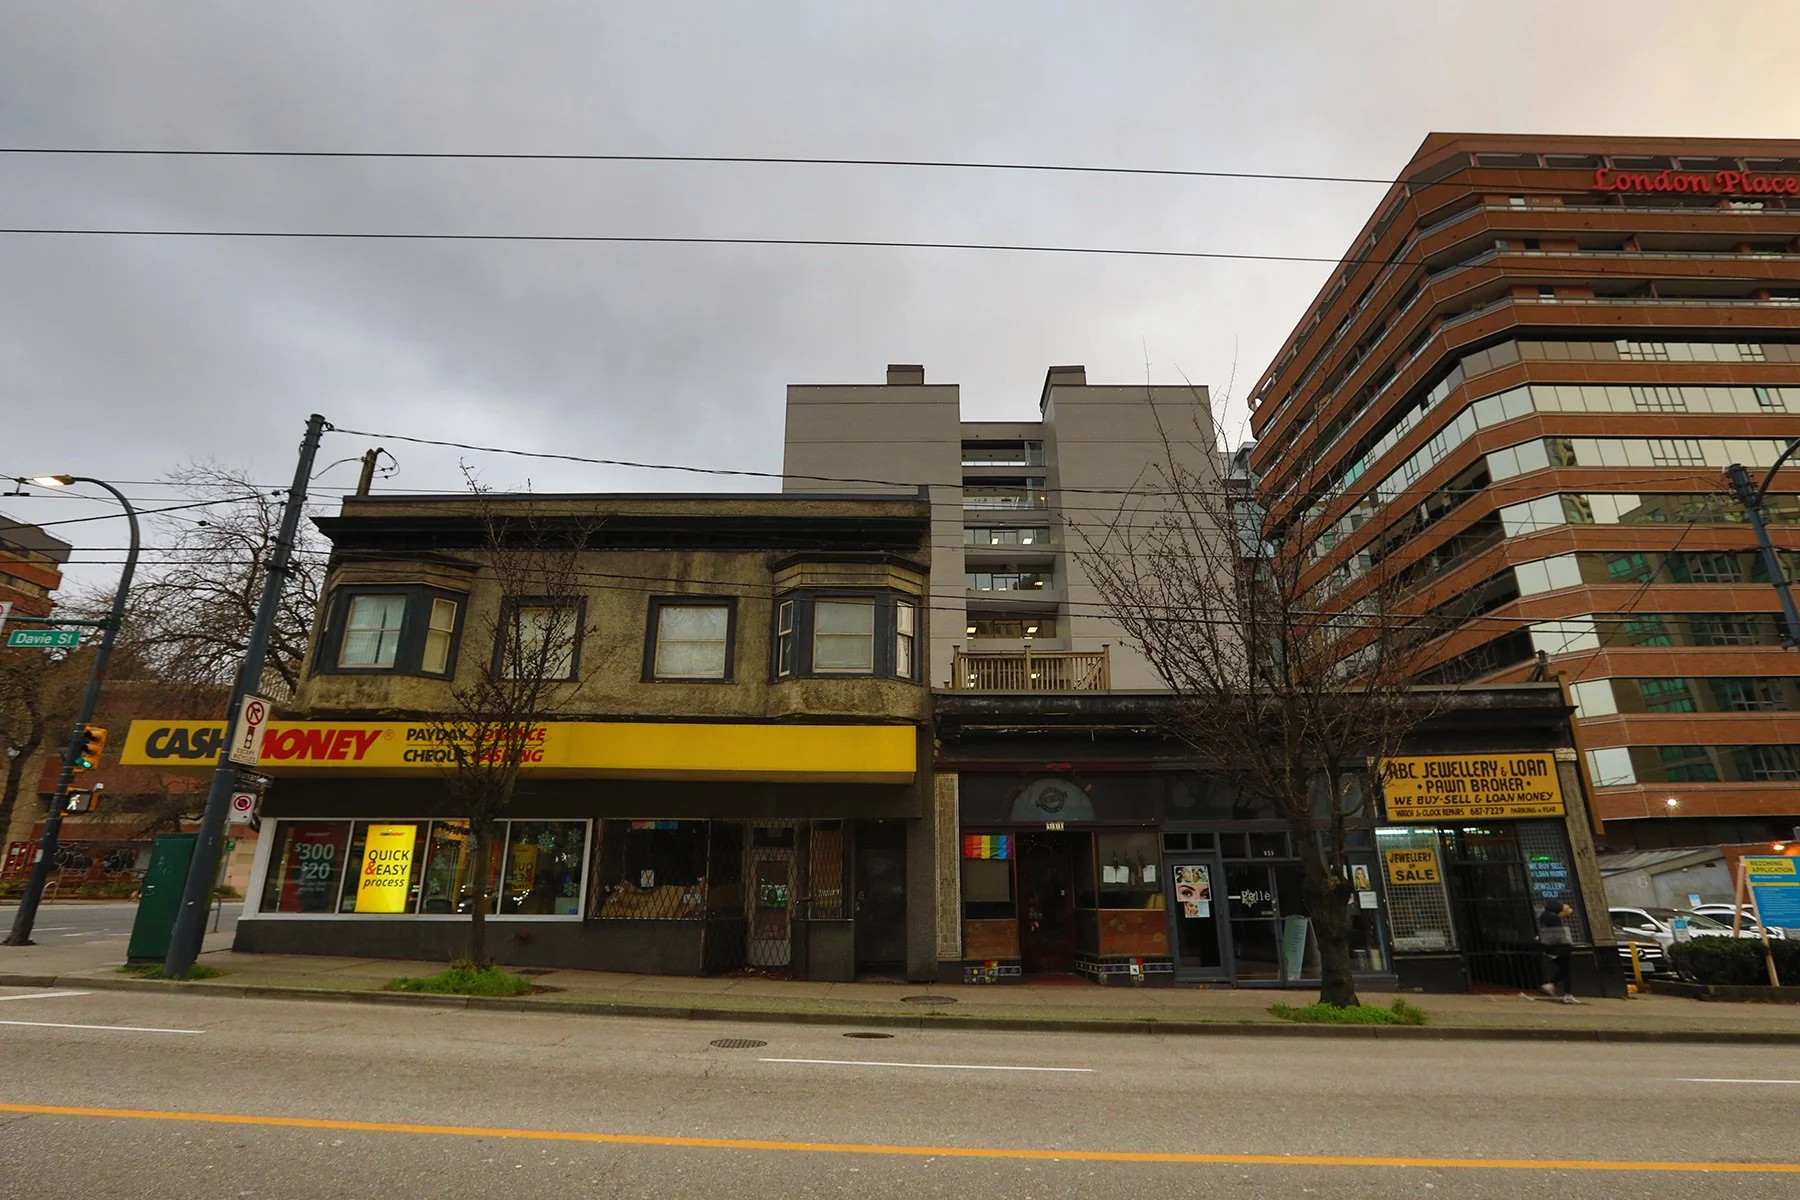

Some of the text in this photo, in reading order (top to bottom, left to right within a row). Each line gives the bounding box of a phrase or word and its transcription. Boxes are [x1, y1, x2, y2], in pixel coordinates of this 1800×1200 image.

[1592, 168, 1799, 193] London Place
[16, 633, 73, 644] Davie St
[471, 749, 545, 763] ASNG
[1422, 760, 1498, 778] JEWELLERY
[1500, 766, 1508, 777] &
[1509, 759, 1548, 776] LOAN
[1425, 778, 1525, 793] PAWN BROKER
[1394, 796, 1412, 805] WE
[1474, 794, 1482, 803] &
[1486, 793, 1515, 803] LOAN
[1517, 792, 1554, 801] MONEY
[1422, 808, 1441, 817] CLOCK
[1470, 807, 1504, 816] 687-7229
[294, 842, 335, 860] $300
[368, 849, 410, 862] QUICK
[1389, 852, 1432, 863] JEWELLERY
[301, 862, 331, 880] $20
[1396, 869, 1435, 881] SALE
[363, 878, 405, 889] process
